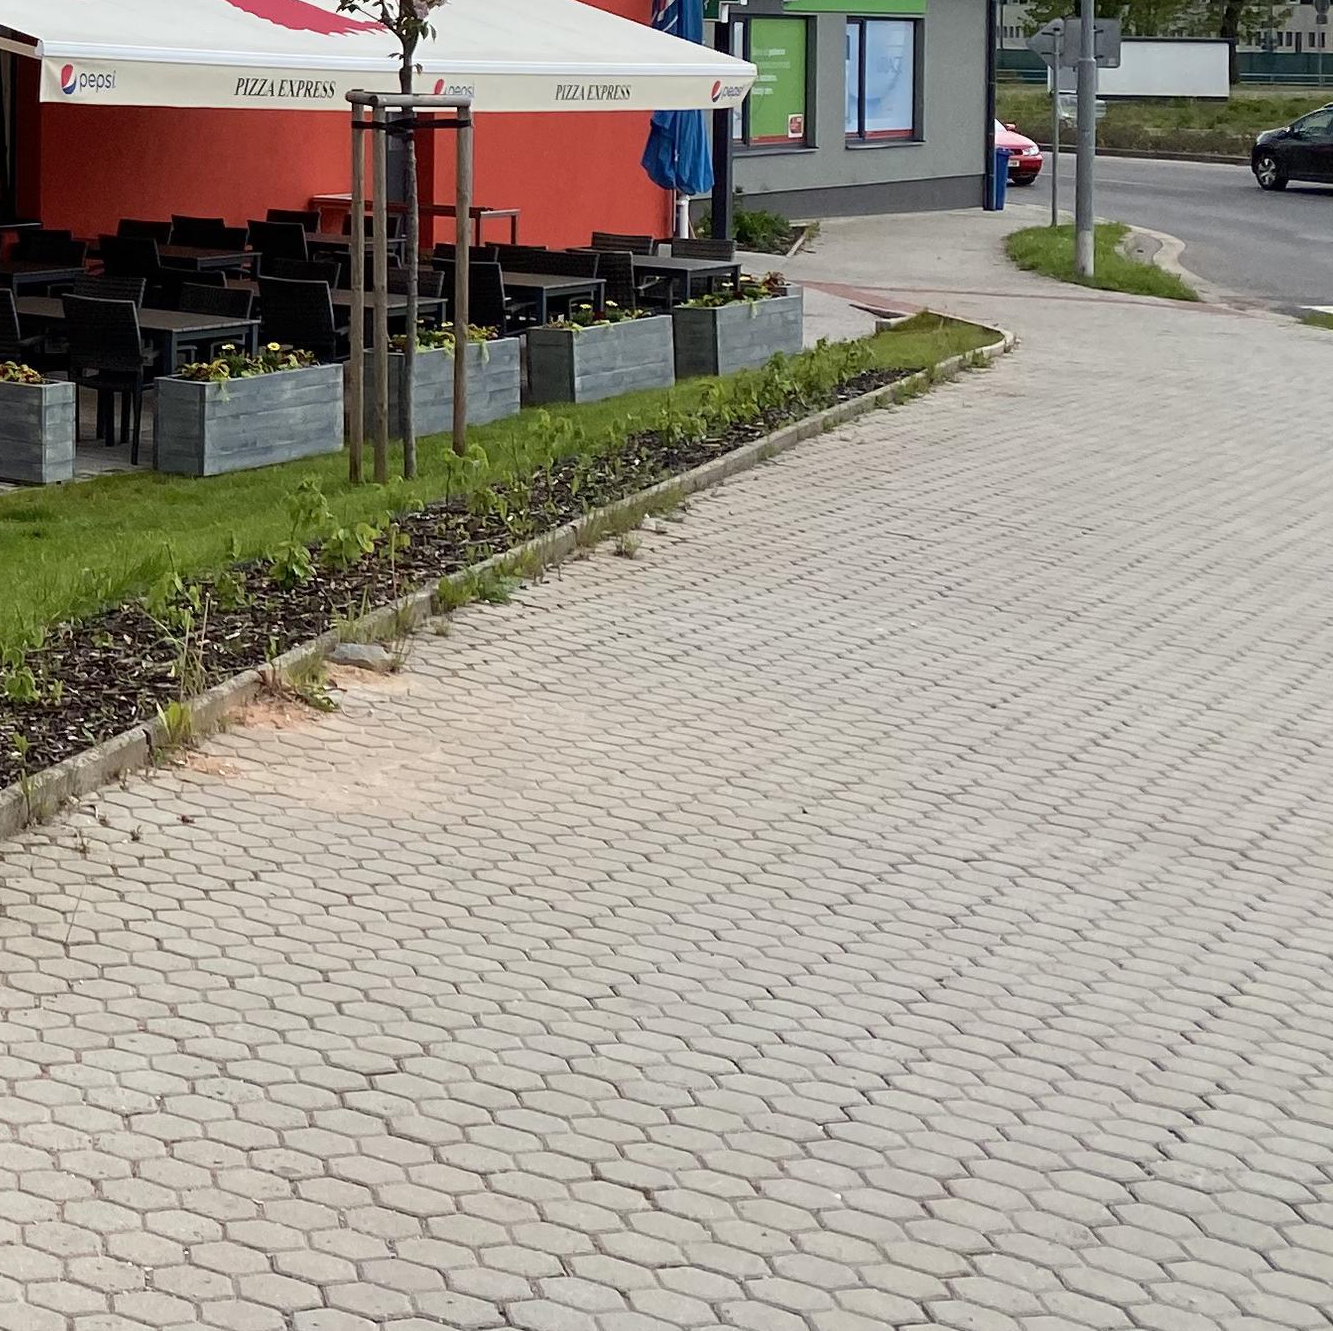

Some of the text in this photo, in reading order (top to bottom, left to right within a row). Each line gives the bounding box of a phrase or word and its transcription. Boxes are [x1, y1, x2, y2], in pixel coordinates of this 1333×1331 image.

[79, 70, 116, 94] pepsi
[234, 77, 275, 98] PIZZA
[278, 79, 337, 100] EXPRESS
[554, 84, 585, 101] PIZZA
[586, 84, 632, 101] EXPRESS
